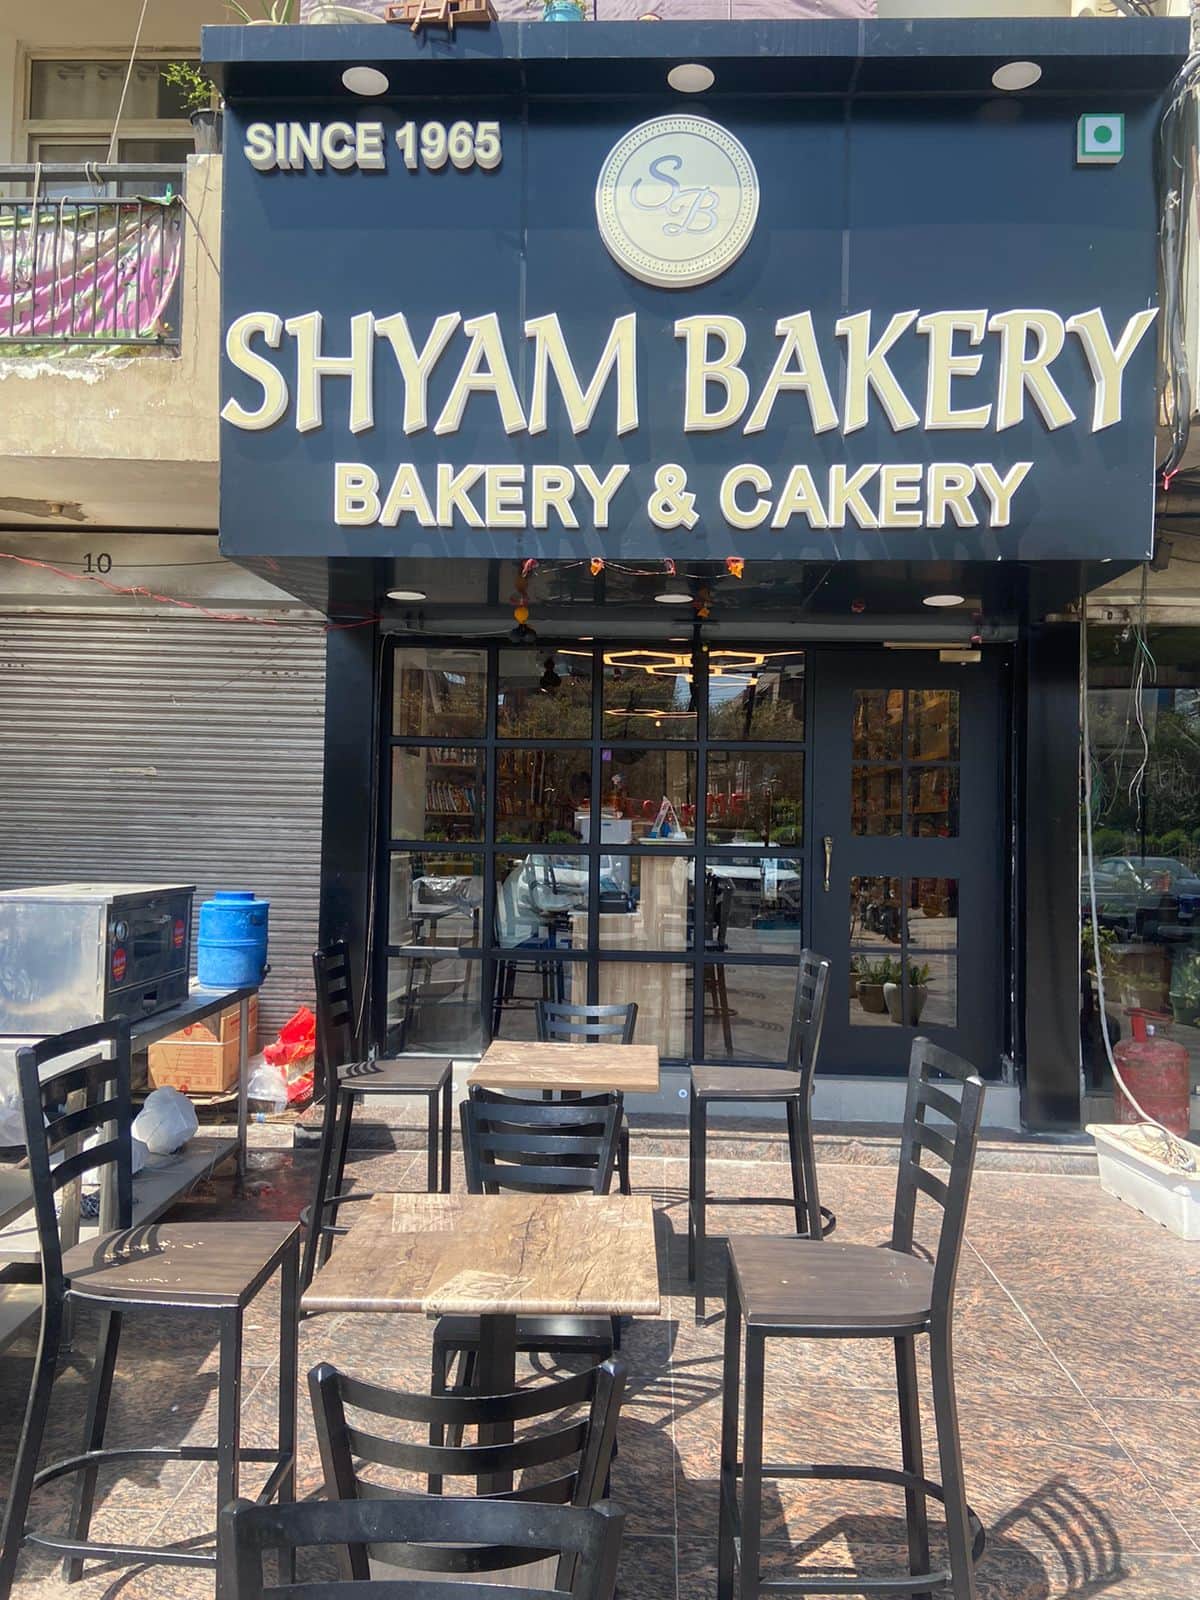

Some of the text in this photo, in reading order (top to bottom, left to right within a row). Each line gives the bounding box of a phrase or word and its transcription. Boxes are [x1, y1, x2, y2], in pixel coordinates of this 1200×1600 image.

[244, 120, 502, 170] SINCE 1965
[220, 307, 1159, 435] SHYAM BAKERY
[334, 462, 1034, 530] BAKERY & CAKERY
[82, 553, 112, 574] 10
